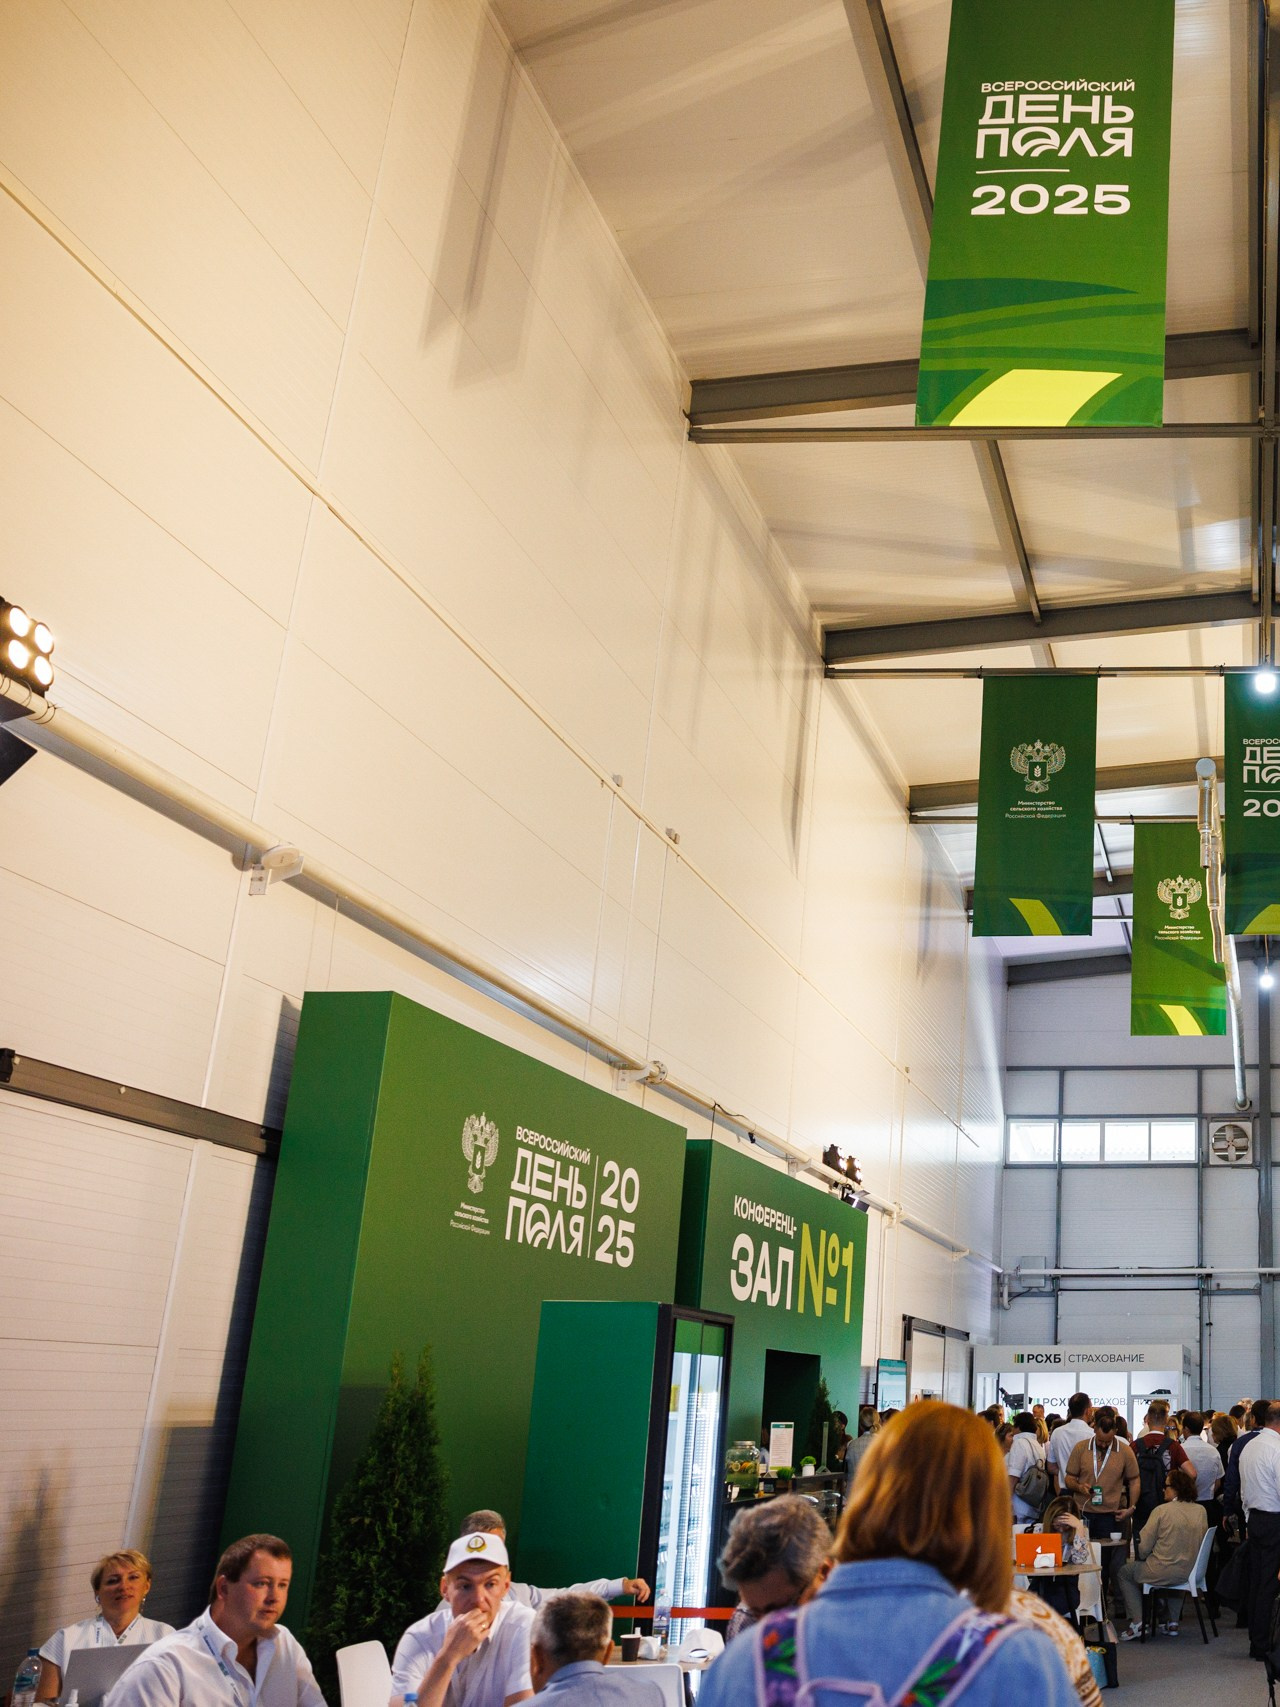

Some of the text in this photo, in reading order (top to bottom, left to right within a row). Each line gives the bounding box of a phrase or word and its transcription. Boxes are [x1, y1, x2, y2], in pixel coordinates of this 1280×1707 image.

[981, 79, 1135, 92] ВСЕРОССИЙСКИЙ
[978, 94, 1134, 125] ДЕНЬ
[976, 126, 1133, 158] ПОЛЯ
[971, 184, 1130, 215] 2025
[516, 1126, 590, 1165] ВСЕРОССИЙСКИЙ
[511, 1148, 587, 1210] ДЕНЬ
[600, 1160, 640, 1214] 20
[505, 1196, 584, 1256] ПОЛЯ
[734, 1195, 797, 1239] КОНФЕРЕНЦ-
[595, 1214, 636, 1268] 25
[730, 1222, 854, 1324] ЗАЛ №1
[1027, 1353, 1144, 1364] РСХБ СТРАХОВАНИЕ
[1043, 1398, 1070, 1406] РСХ
